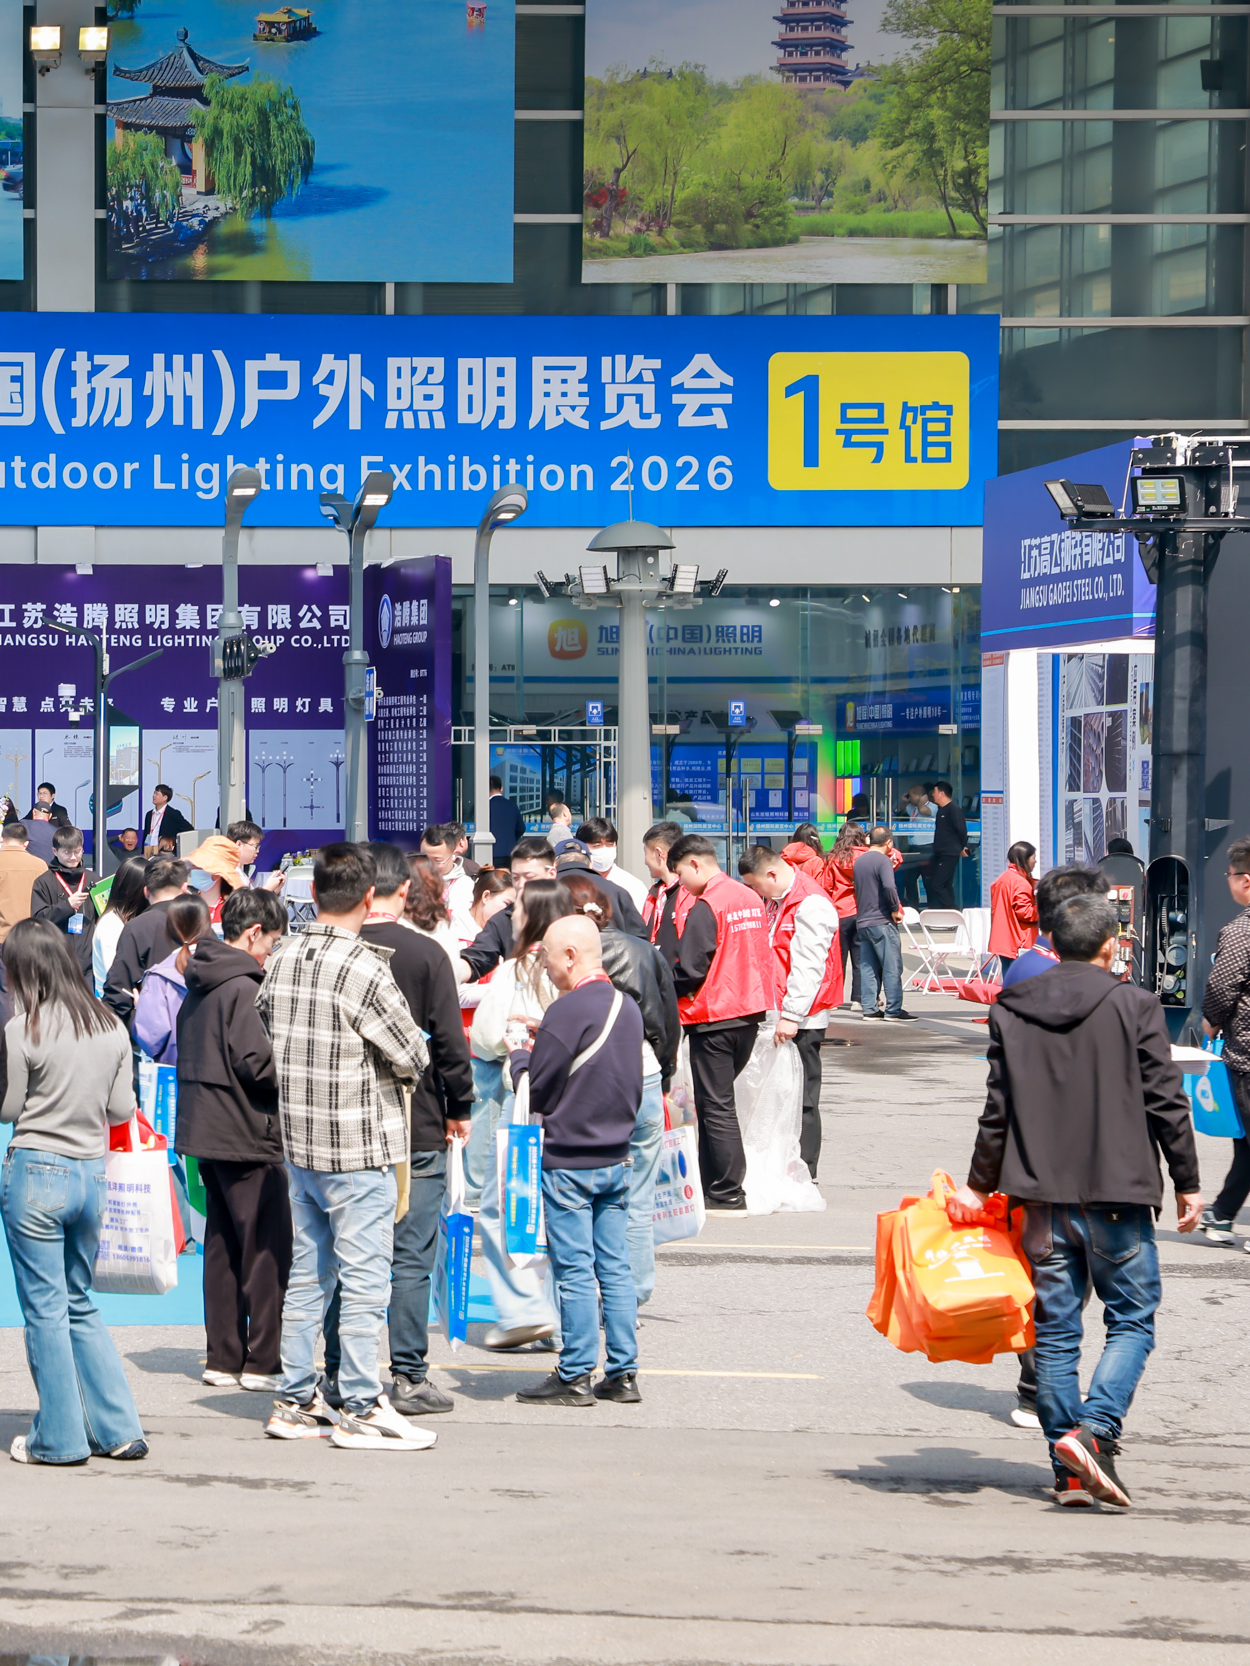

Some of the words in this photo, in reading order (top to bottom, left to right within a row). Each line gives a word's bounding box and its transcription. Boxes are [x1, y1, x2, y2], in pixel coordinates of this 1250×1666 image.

[783, 374, 954, 468] 1号馆
[153, 453, 345, 499] Lighting
[360, 453, 594, 492] Exhibition
[610, 455, 733, 491] 2026
[1021, 531, 1125, 580] 江苏高飞钢铁有限公司
[1020, 584, 1047, 610] JIANGSU
[1049, 580, 1072, 604] GAOFEI
[1073, 577, 1093, 602] STEEL
[1109, 573, 1125, 598] LTD.
[394, 599, 428, 628] 浩腾集团
[291, 635, 350, 649] CO.,LTD
[554, 626, 582, 652] 旭
[598, 624, 763, 646] 旭(中国)照明
[40, 696, 114, 714] 点亮未
[160, 697, 334, 714] 专业户照明灯具
